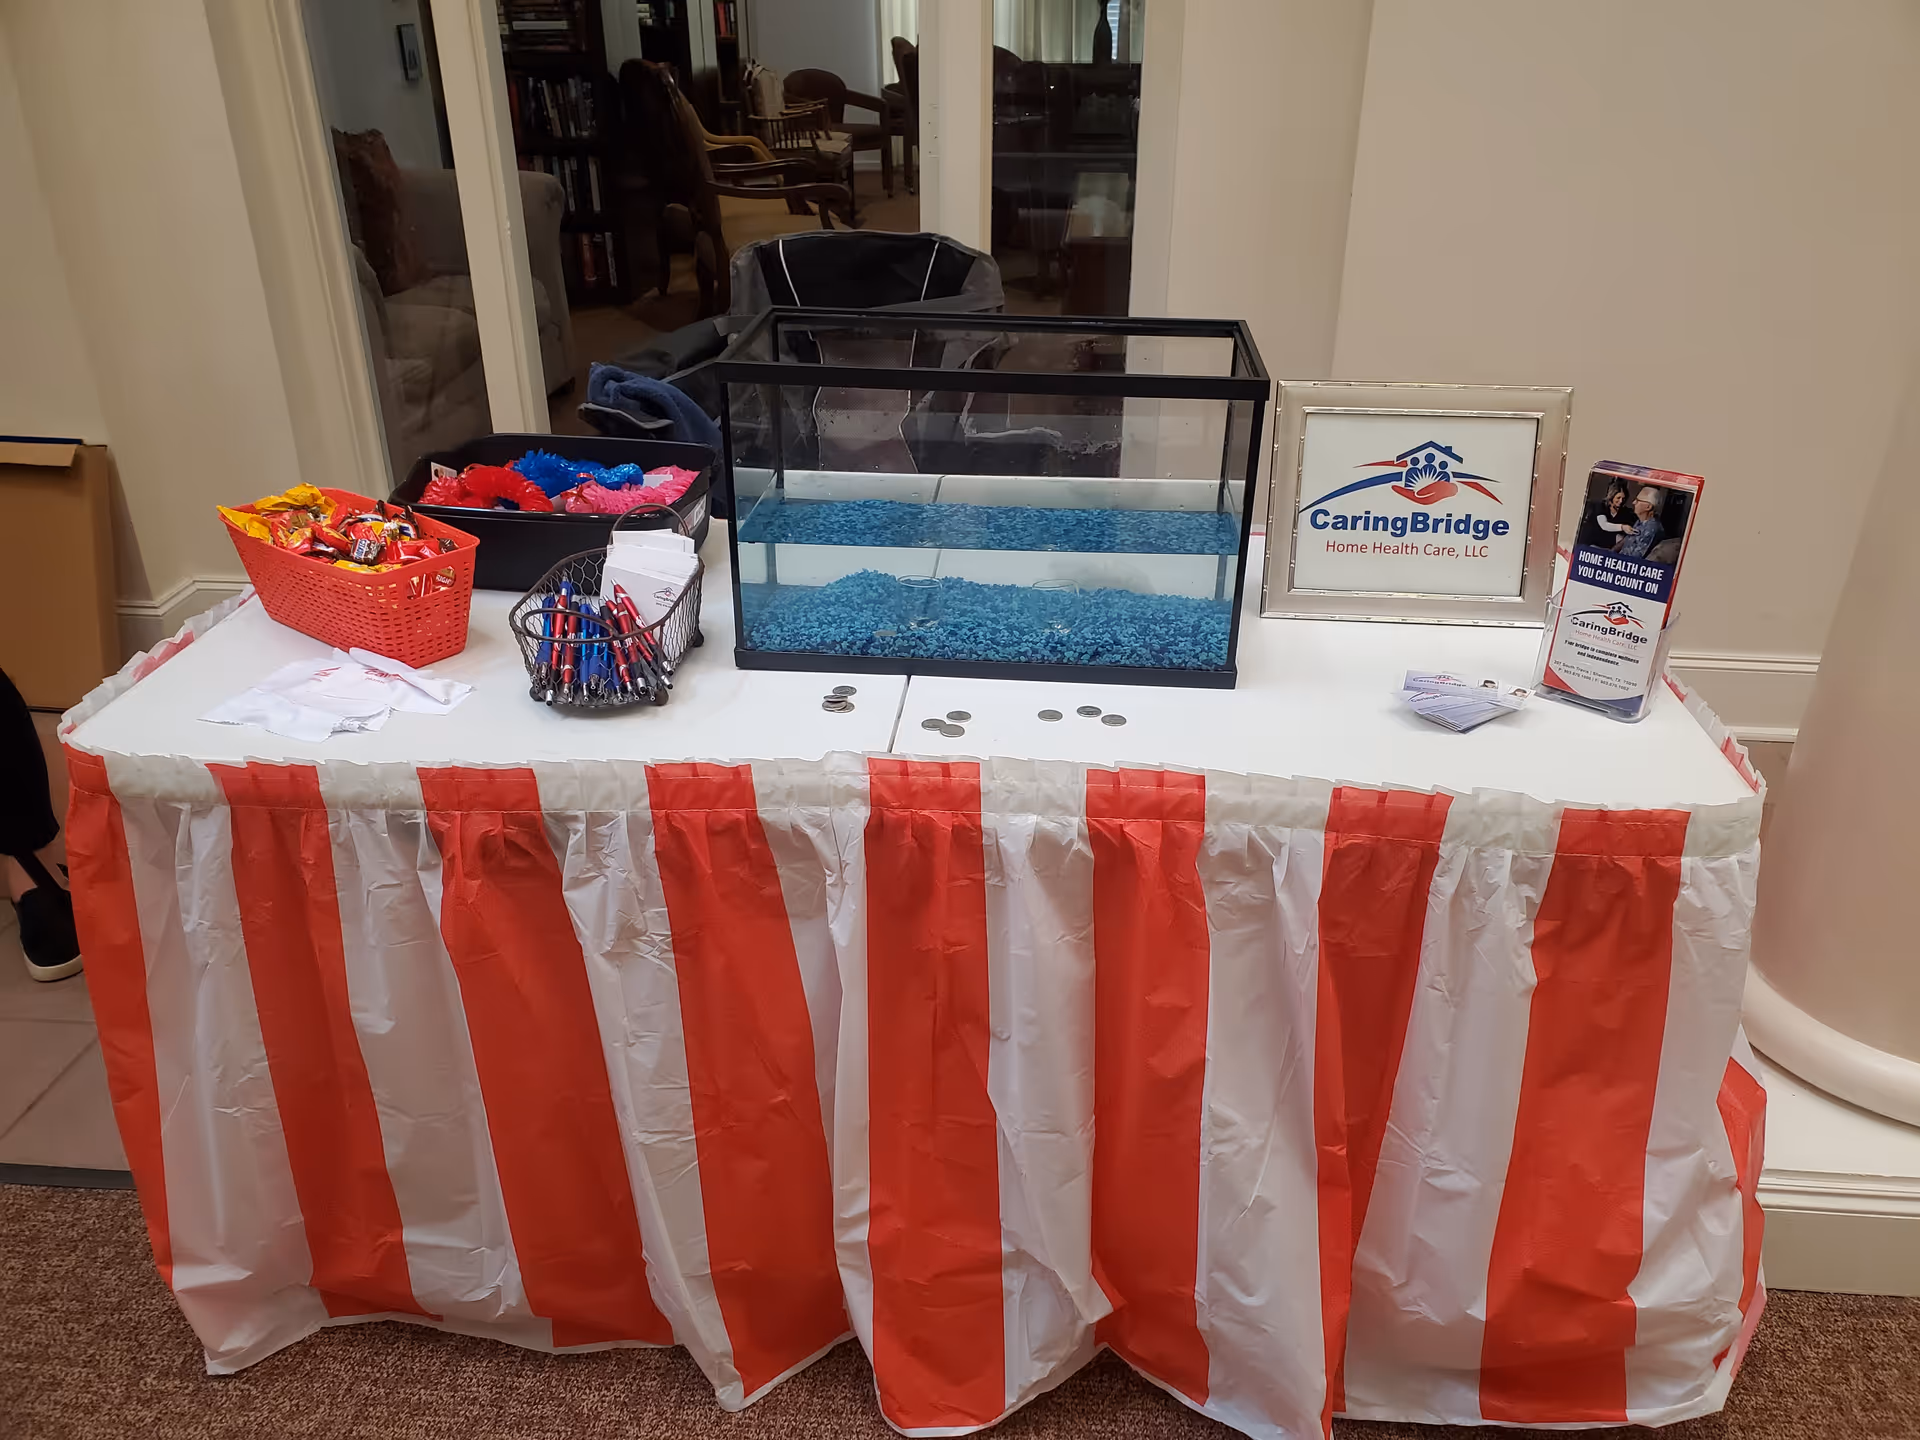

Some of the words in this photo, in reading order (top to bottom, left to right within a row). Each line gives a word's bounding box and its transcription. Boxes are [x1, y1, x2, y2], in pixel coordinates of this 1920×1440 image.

[1310, 508, 1510, 541] CaringBridge
[1326, 540, 1368, 554] Home
[1372, 541, 1419, 556] Health
[1423, 543, 1459, 559] Care,
[1464, 545, 1489, 558] LLC
[1578, 550, 1604, 566] HOME
[1604, 556, 1639, 575] HEALTH
[1639, 565, 1665, 581] CARE
[1577, 564, 1595, 579] YOU
[1595, 569, 1614, 584] CAN
[1614, 574, 1645, 591] COUNT
[1645, 582, 1659, 595] ON
[1570, 616, 1648, 644] CaringBridge
[1575, 629, 1592, 638] Home
[1592, 634, 1611, 644] Health
[1562, 661, 1575, 669] South
[1575, 642, 1590, 651] bridge
[1595, 648, 1618, 658] complete
[1618, 654, 1640, 664] wellness
